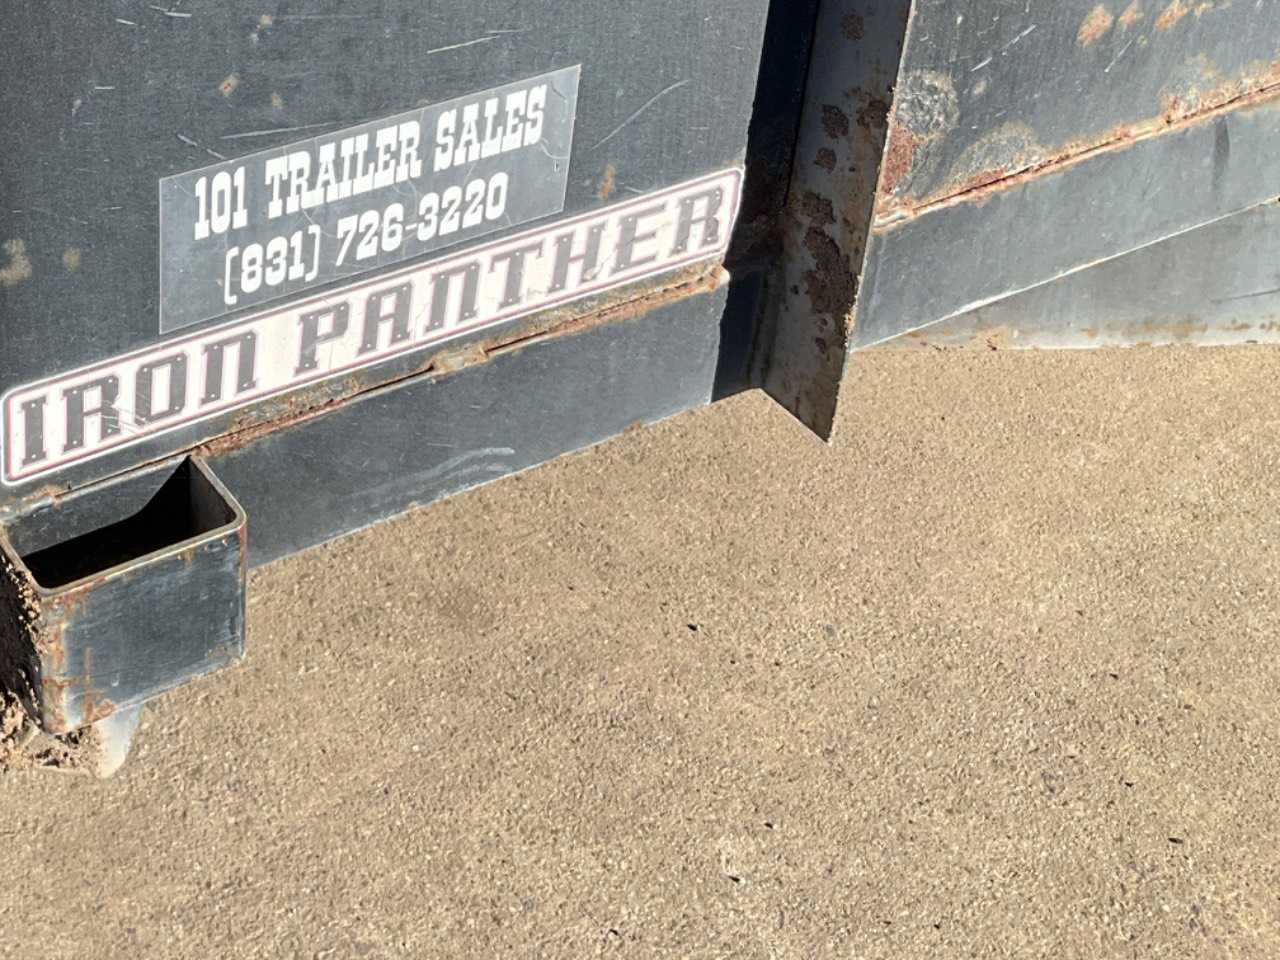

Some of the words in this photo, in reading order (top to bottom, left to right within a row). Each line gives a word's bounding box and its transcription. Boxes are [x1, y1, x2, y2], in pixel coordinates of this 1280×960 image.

[194, 165, 249, 241] 101
[265, 119, 423, 220] TRAILER
[433, 83, 549, 172] SALES
[224, 224, 321, 305] (831)
[335, 171, 509, 267] 726-3220
[21, 330, 258, 466] IRON
[292, 184, 727, 379] PANTHER
